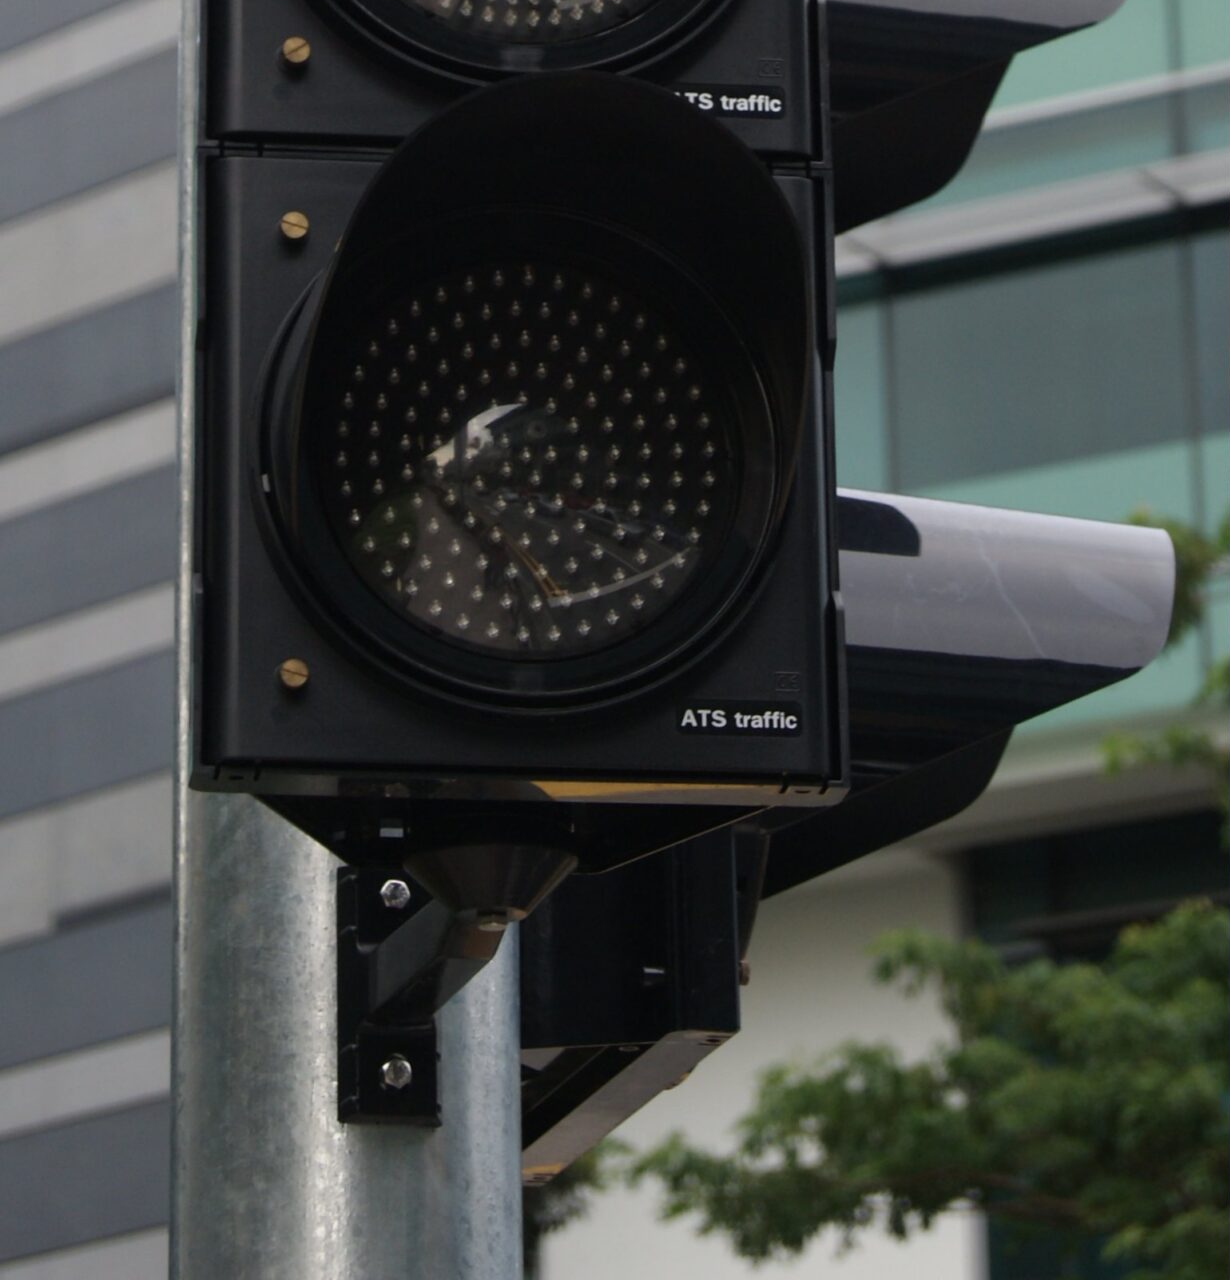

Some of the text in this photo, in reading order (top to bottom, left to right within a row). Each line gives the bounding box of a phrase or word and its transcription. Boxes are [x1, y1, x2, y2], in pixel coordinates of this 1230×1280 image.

[674, 92, 782, 112] TS traffic
[680, 709, 798, 729] ATS traffic
